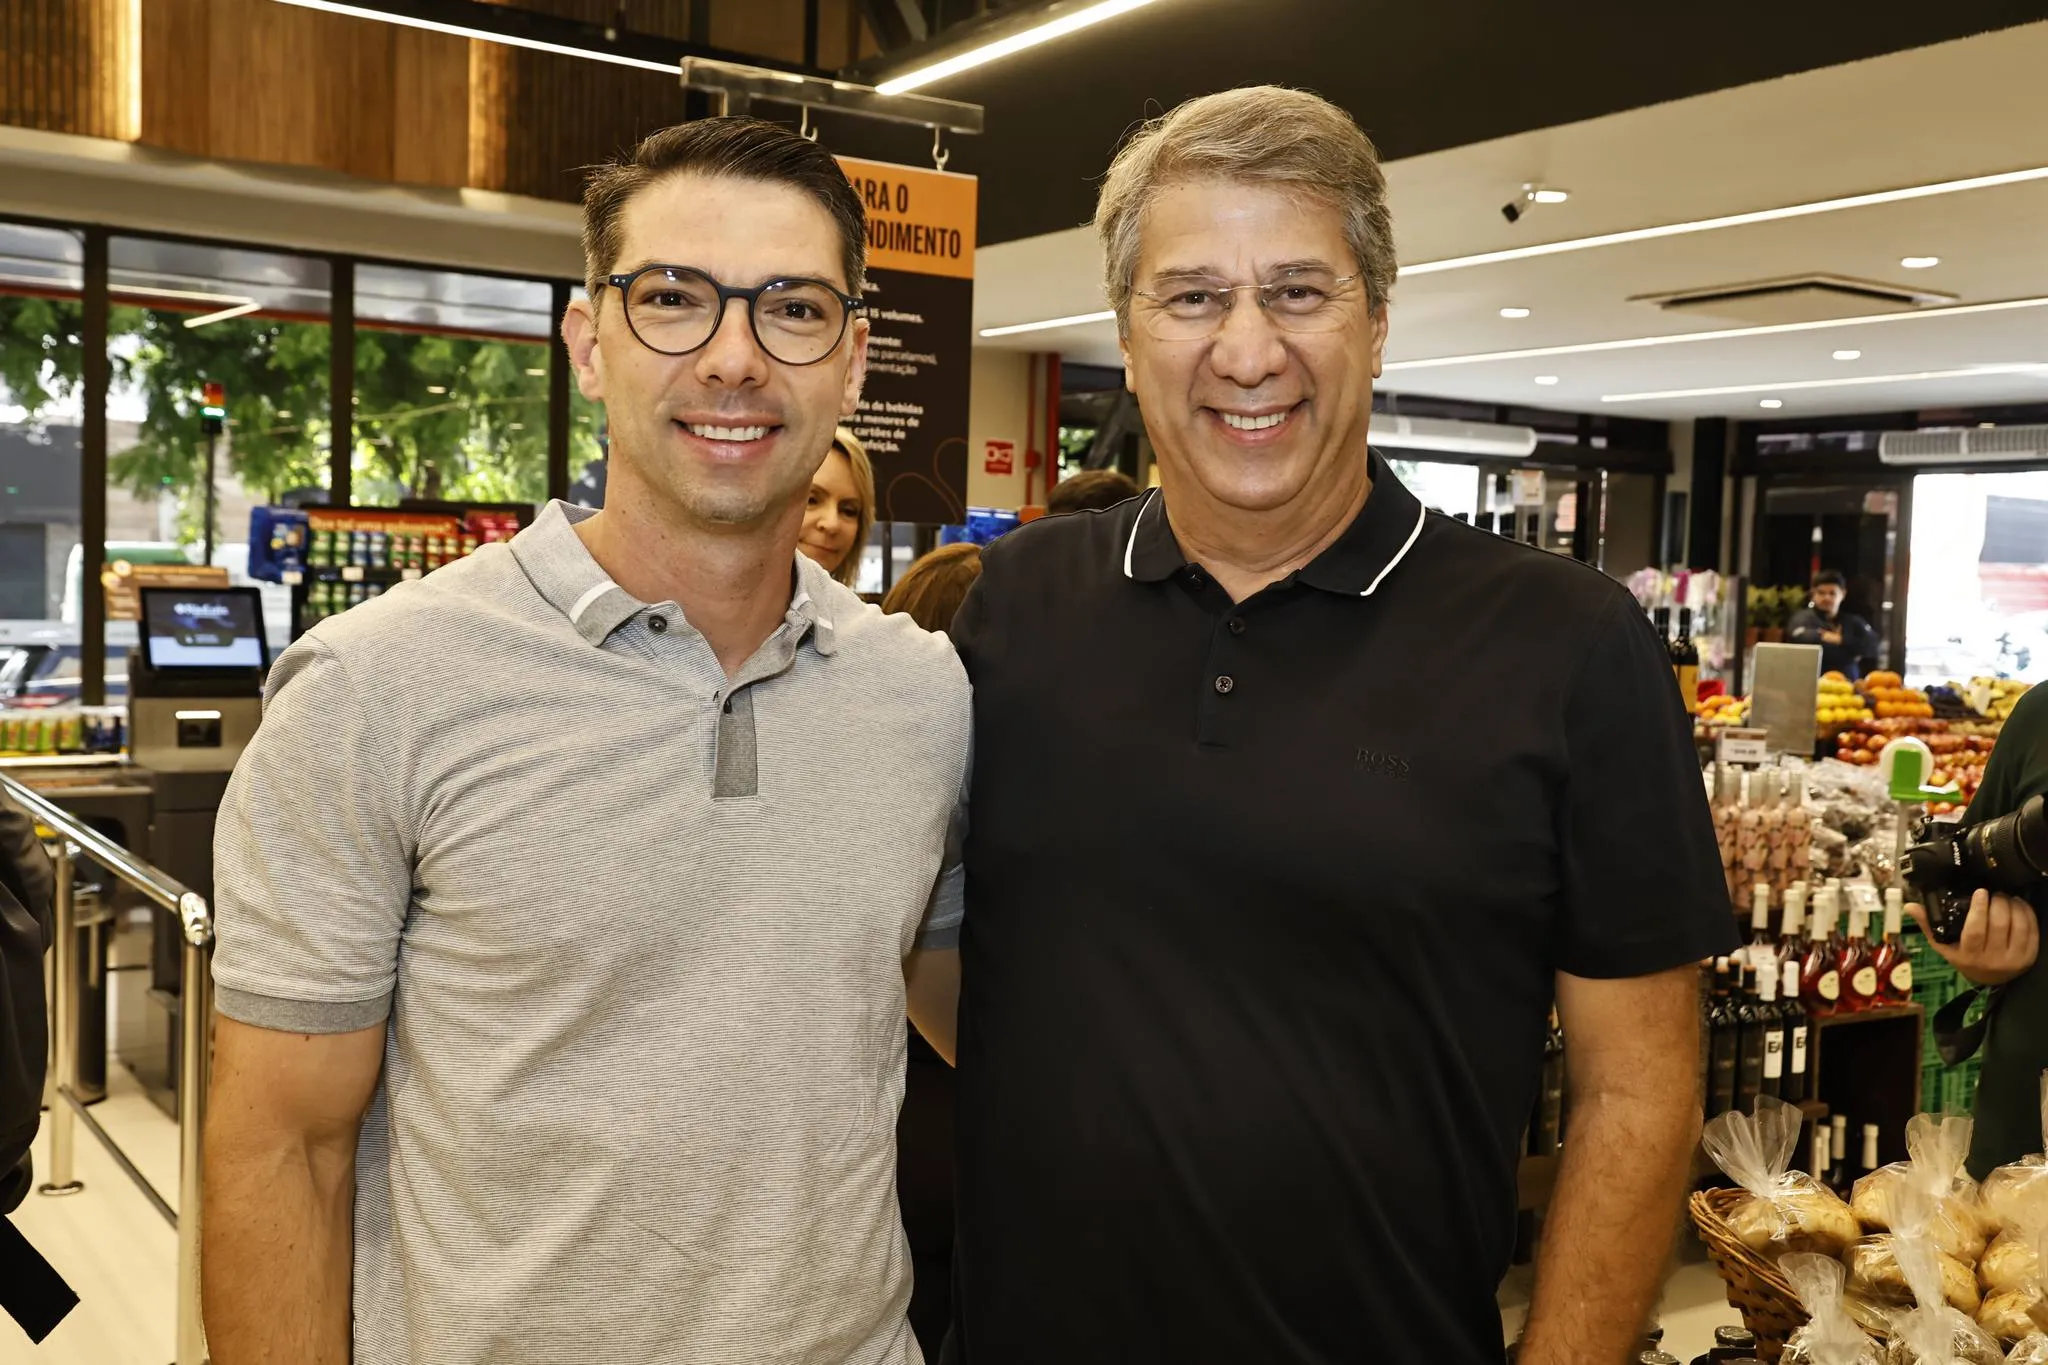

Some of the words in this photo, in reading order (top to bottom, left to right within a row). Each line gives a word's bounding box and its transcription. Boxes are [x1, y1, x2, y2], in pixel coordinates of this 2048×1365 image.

[897, 183, 909, 214] O
[865, 219, 961, 259] NDIMENTO
[867, 361, 918, 375] limentação
[885, 401, 923, 415] bebidas
[906, 416, 919, 427] de
[1356, 747, 1409, 773] BOSS
